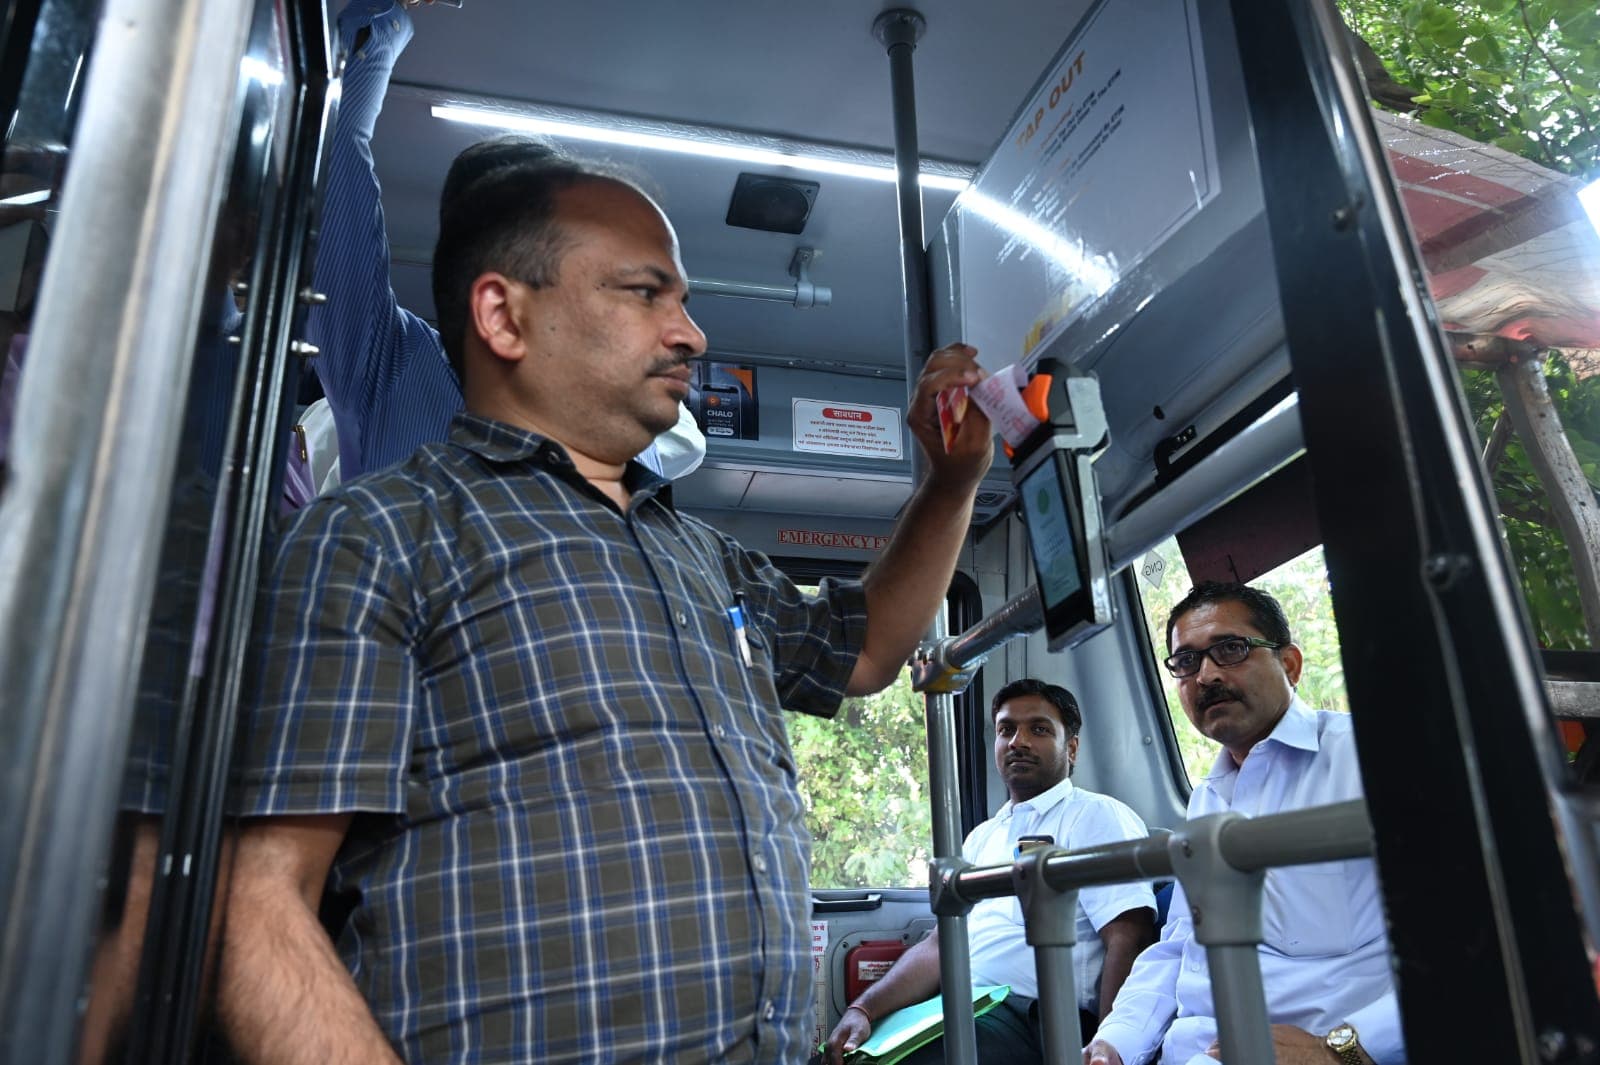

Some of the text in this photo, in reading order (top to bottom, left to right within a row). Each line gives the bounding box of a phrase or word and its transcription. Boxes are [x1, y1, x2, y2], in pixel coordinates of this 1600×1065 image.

[1015, 107, 1044, 148] TAP
[1049, 50, 1085, 109] OUT
[707, 410, 734, 418] CHALO
[779, 530, 870, 550] EMERGENCY
